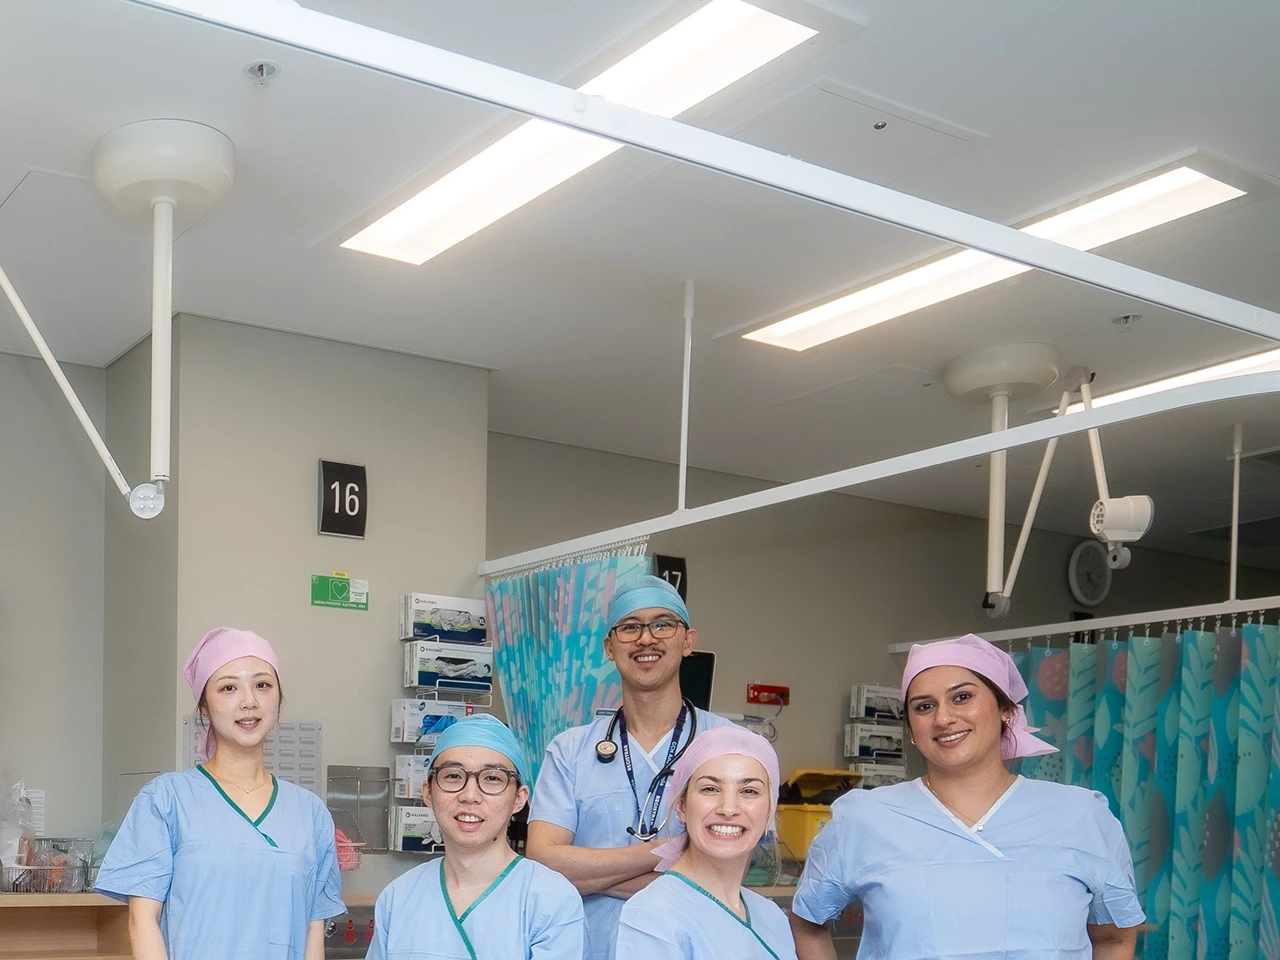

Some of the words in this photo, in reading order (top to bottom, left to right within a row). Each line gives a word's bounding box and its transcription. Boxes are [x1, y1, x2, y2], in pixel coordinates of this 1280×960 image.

[331, 481, 360, 516] 16
[663, 570, 682, 591] 17
[623, 744, 631, 771] REGISTRAR
